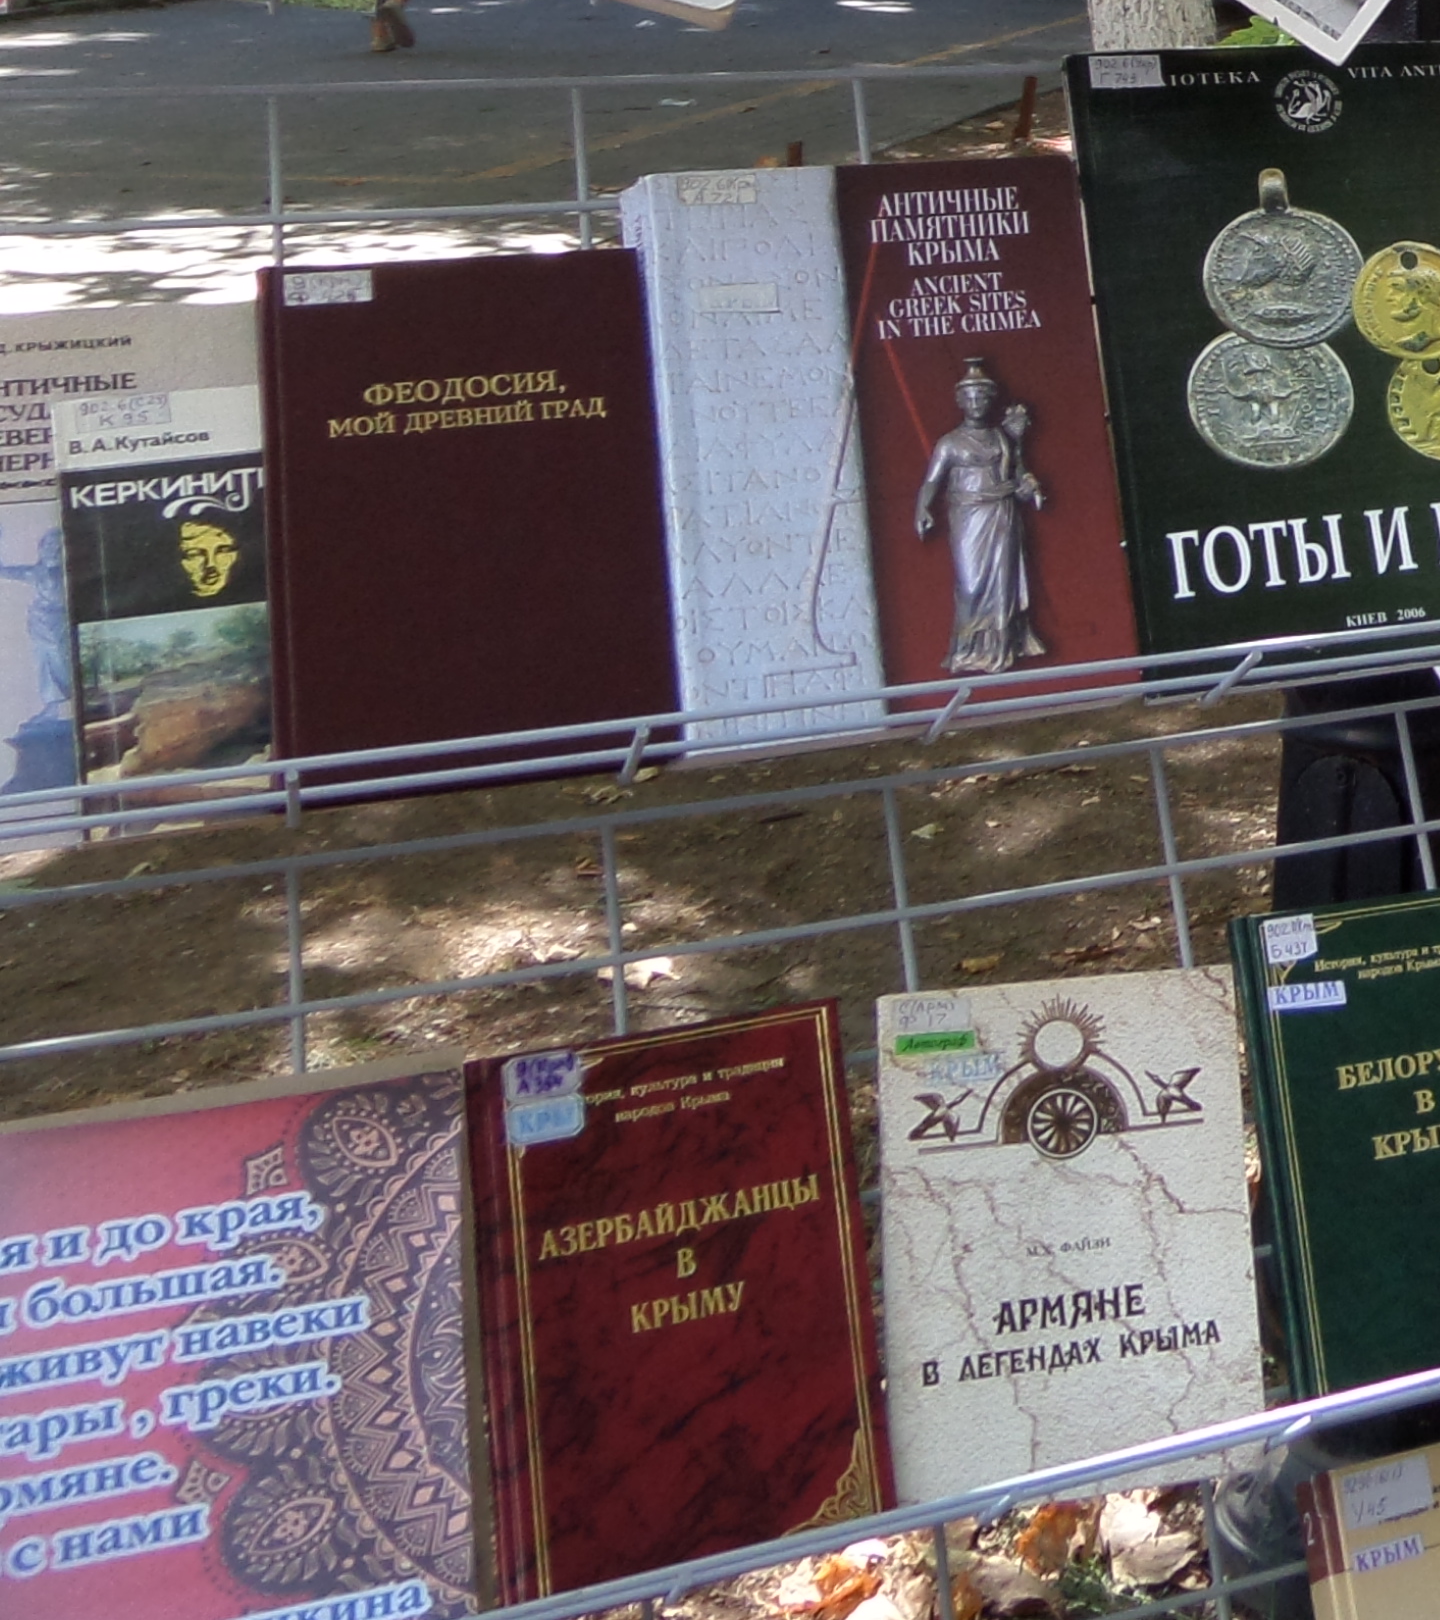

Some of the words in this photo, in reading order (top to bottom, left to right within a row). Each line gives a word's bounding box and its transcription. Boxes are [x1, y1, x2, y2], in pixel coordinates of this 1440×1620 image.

[1347, 66, 1393, 79] VITA
[877, 185, 1020, 218] АНТИЧНЫЕ
[869, 211, 1031, 244] ПАМЯТНИКИ
[907, 234, 1001, 267] КРЫМА
[910, 270, 1002, 297] ANCIENT
[887, 293, 962, 319] GREEK
[969, 289, 1029, 314] SITES
[877, 315, 900, 340] IN
[904, 311, 955, 337] THE
[961, 306, 1043, 335] CRIMEA
[15, 335, 132, 352] КРЫЖИЦКИЙ
[363, 370, 566, 406] ФЕОДОСИЯ,
[327, 411, 396, 438] МОЙ
[404, 400, 534, 434] ДРЕВНИЙ
[115, 431, 209, 452] Кутайсов
[1165, 517, 1347, 600] ГОТЫ
[1344, 611, 1390, 629] КИЕВ
[1395, 605, 1427, 623] 2006
[1276, 982, 1339, 1004] КРЫМ
[1414, 1089, 1434, 1112] В
[101, 1219, 167, 1259] до
[182, 1195, 321, 1242] края,
[537, 1175, 821, 1261] АЗЕРБАЙДЖАНЦЫ
[674, 1249, 697, 1277] В
[26, 1258, 282, 1322] большая.
[629, 1282, 746, 1333] КРЫМУ
[992, 1284, 1147, 1336] АРМЯНЕ
[181, 1300, 365, 1355] навеки
[922, 1358, 941, 1386] В
[958, 1339, 1102, 1381] ЛЕГЕНДАХ
[1118, 1321, 1221, 1359] КРЫМА
[165, 1367, 337, 1421] греки.
[59, 1509, 204, 1562] нами
[1356, 1537, 1419, 1572] КРЫМ
